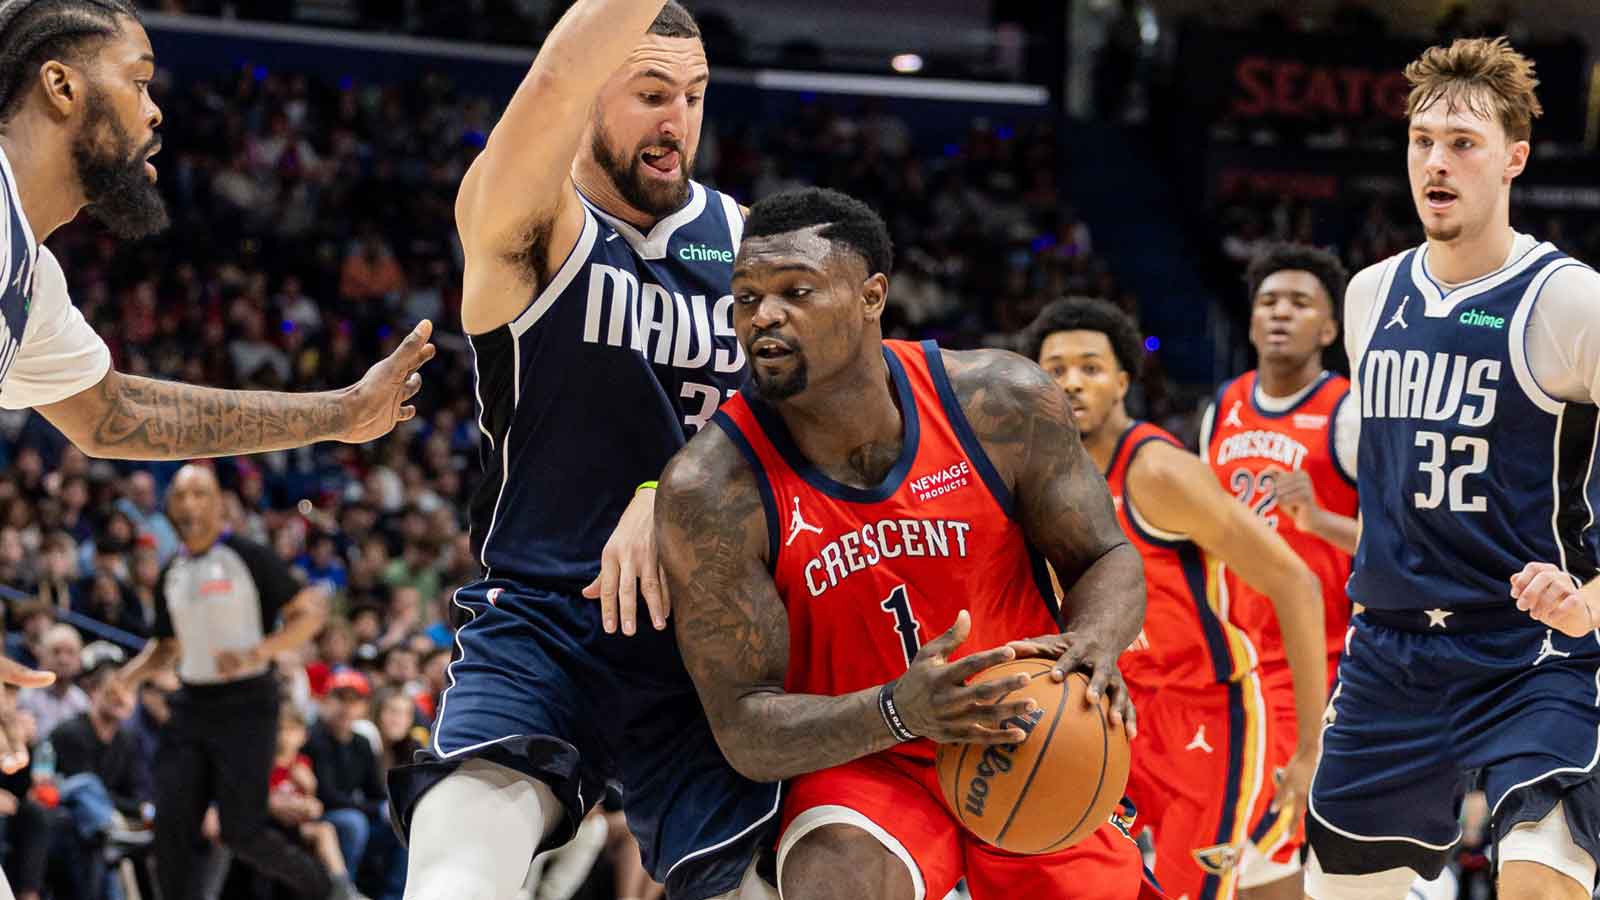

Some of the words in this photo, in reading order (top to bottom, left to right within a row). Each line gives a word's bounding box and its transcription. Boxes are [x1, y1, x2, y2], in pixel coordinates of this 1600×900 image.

[680, 244, 734, 263] chime
[583, 263, 747, 374] MAVS
[1459, 308, 1505, 329] chime
[680, 381, 738, 432] 3
[1362, 349, 1502, 428] MAVS
[910, 461, 969, 493] NEWAGE
[920, 478, 967, 502] PRODUCTS
[1414, 430, 1490, 513] 32
[803, 518, 971, 597] CRESCENT
[880, 584, 920, 669] 1
[965, 708, 1044, 817] Wlson
